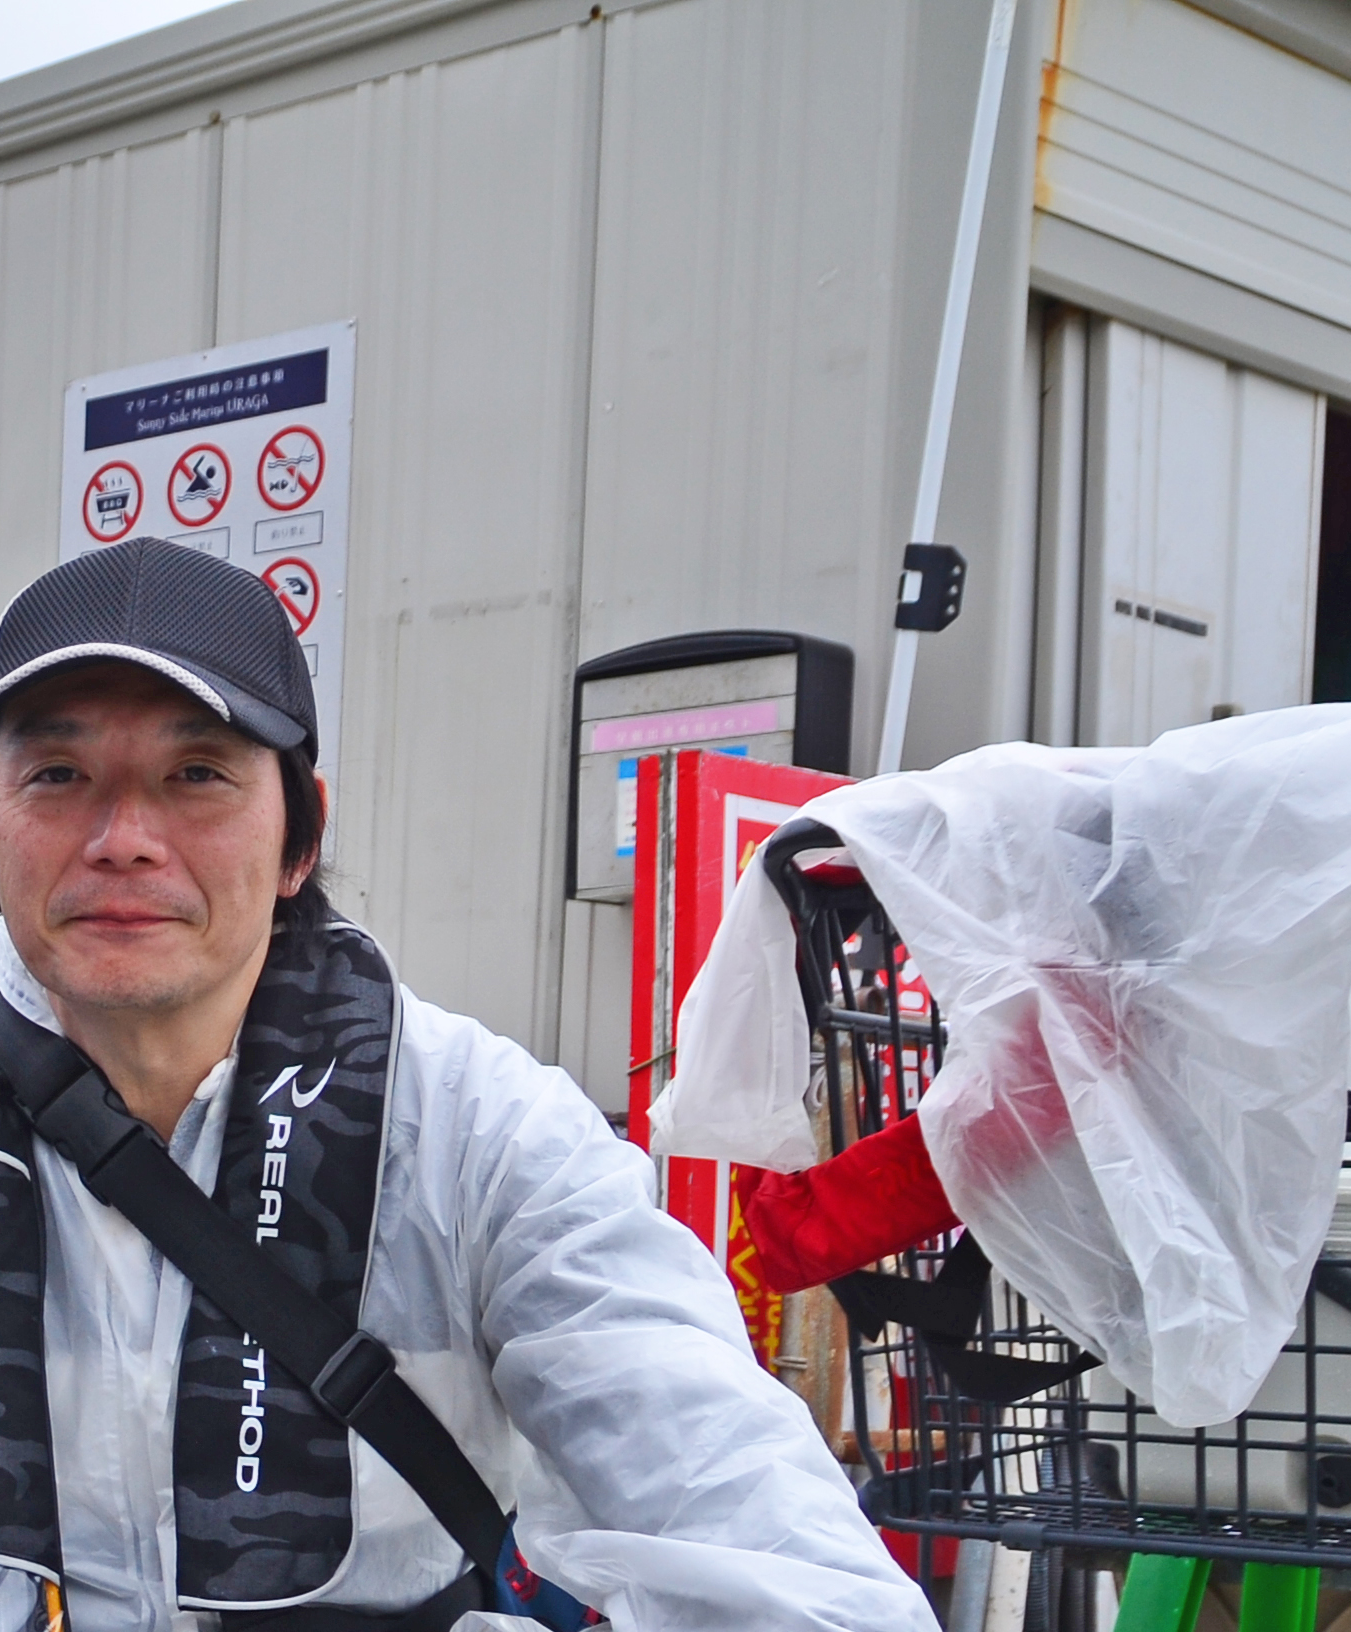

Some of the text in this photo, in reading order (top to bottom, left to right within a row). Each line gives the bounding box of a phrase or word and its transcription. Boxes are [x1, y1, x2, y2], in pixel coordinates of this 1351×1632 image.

[137, 393, 269, 433] Sunny Side Marina URAGA
[235, 1113, 292, 1493] REAL THOD
